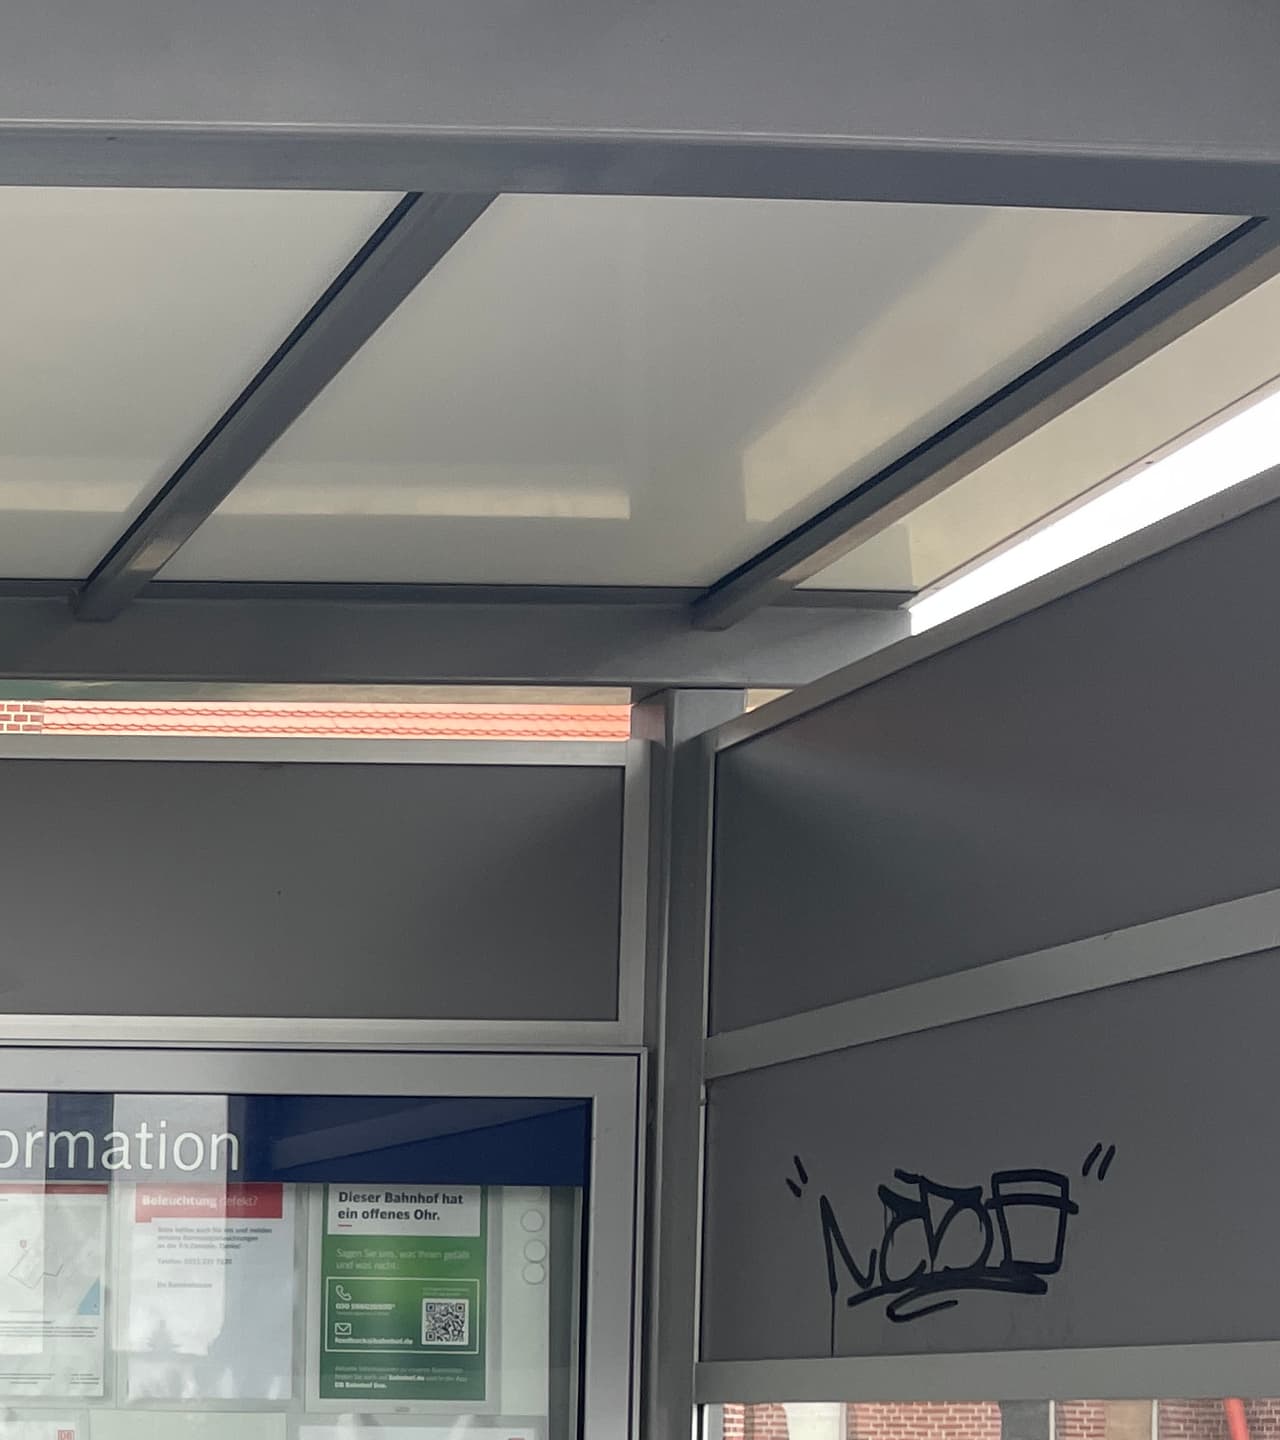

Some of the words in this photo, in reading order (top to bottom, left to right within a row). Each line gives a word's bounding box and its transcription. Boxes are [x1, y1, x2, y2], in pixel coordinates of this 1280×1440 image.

[142, 1195, 217, 1208] Beleuchtung
[338, 1191, 381, 1203] Dieser
[384, 1191, 439, 1204] Bahnhof
[442, 1193, 463, 1204] hat
[338, 1209, 358, 1219] ein
[361, 1209, 410, 1220] offenes
[414, 1209, 441, 1220] Ohr.
